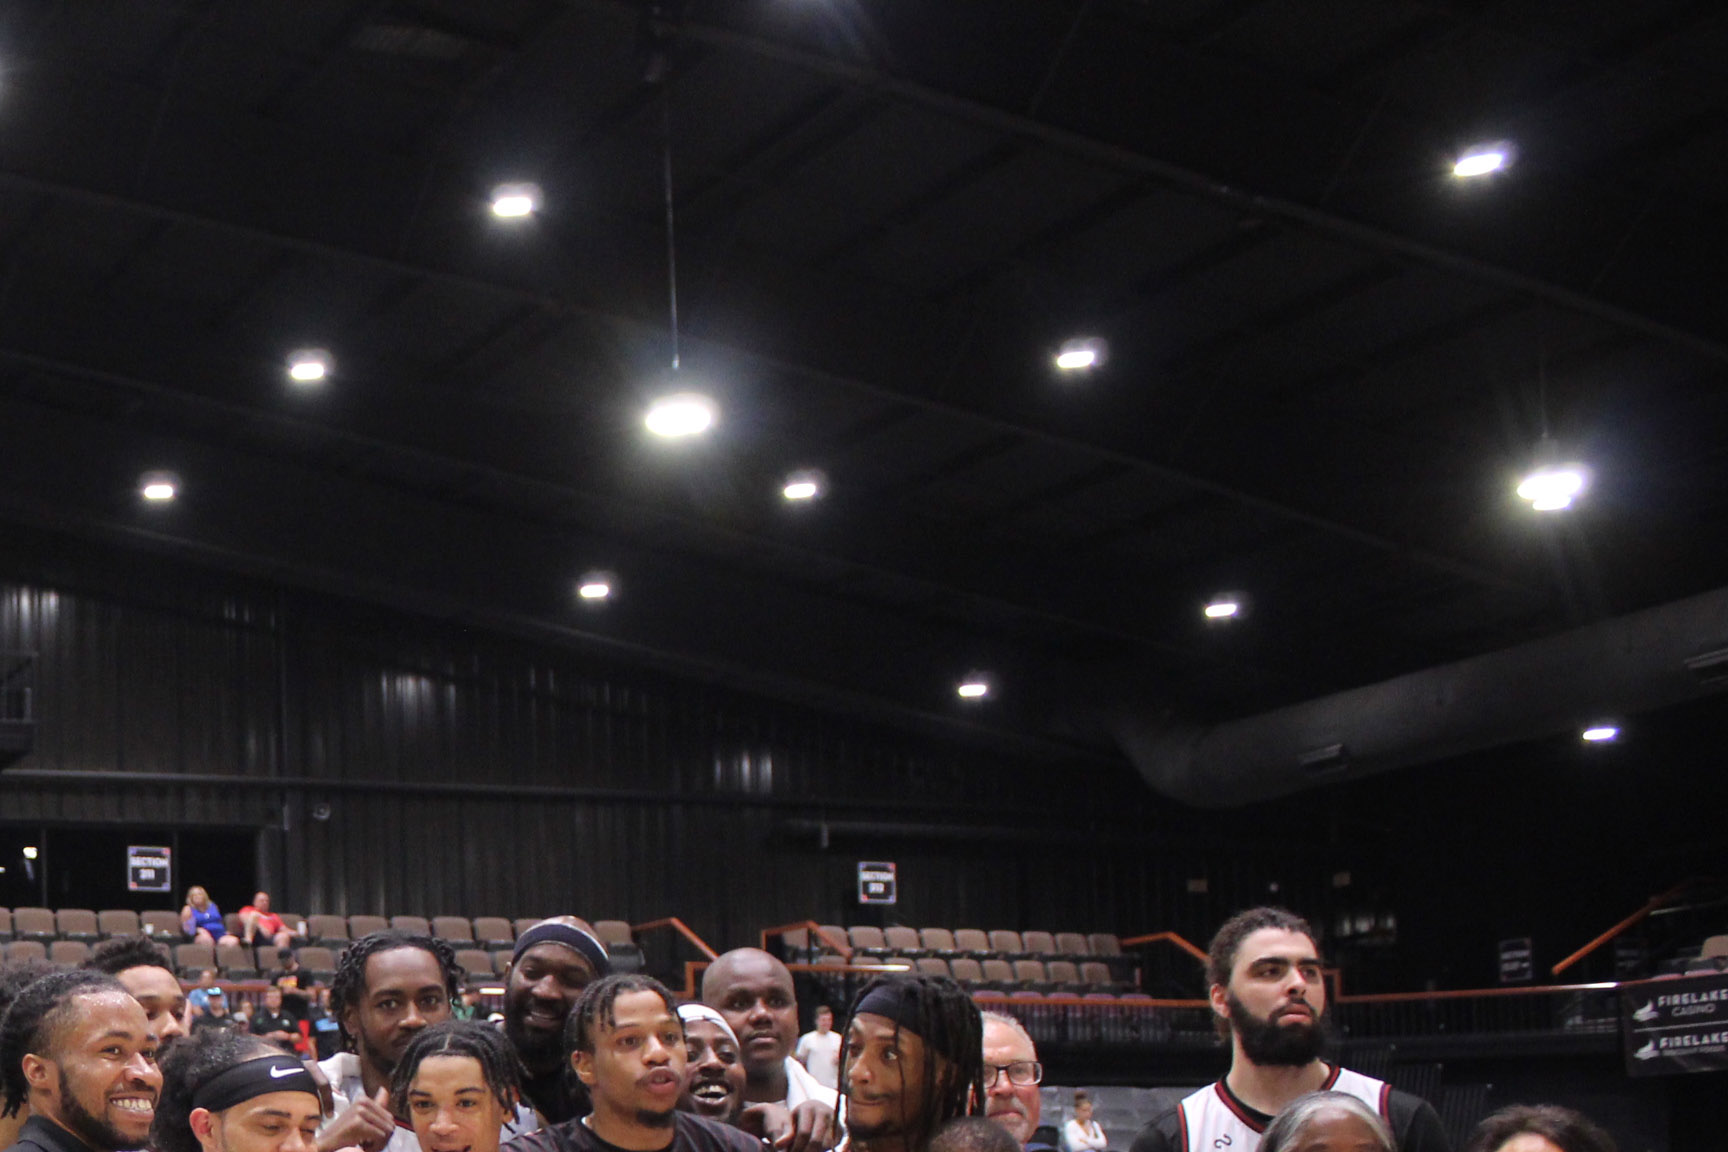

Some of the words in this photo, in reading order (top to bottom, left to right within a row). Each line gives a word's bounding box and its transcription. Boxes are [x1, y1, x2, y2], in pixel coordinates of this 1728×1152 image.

[130, 857, 169, 867] SECTION
[1658, 989, 1728, 1007] FIRELAKE
[1672, 1003, 1716, 1016] CASINO
[1659, 1032, 1728, 1048] FIRELAKE
